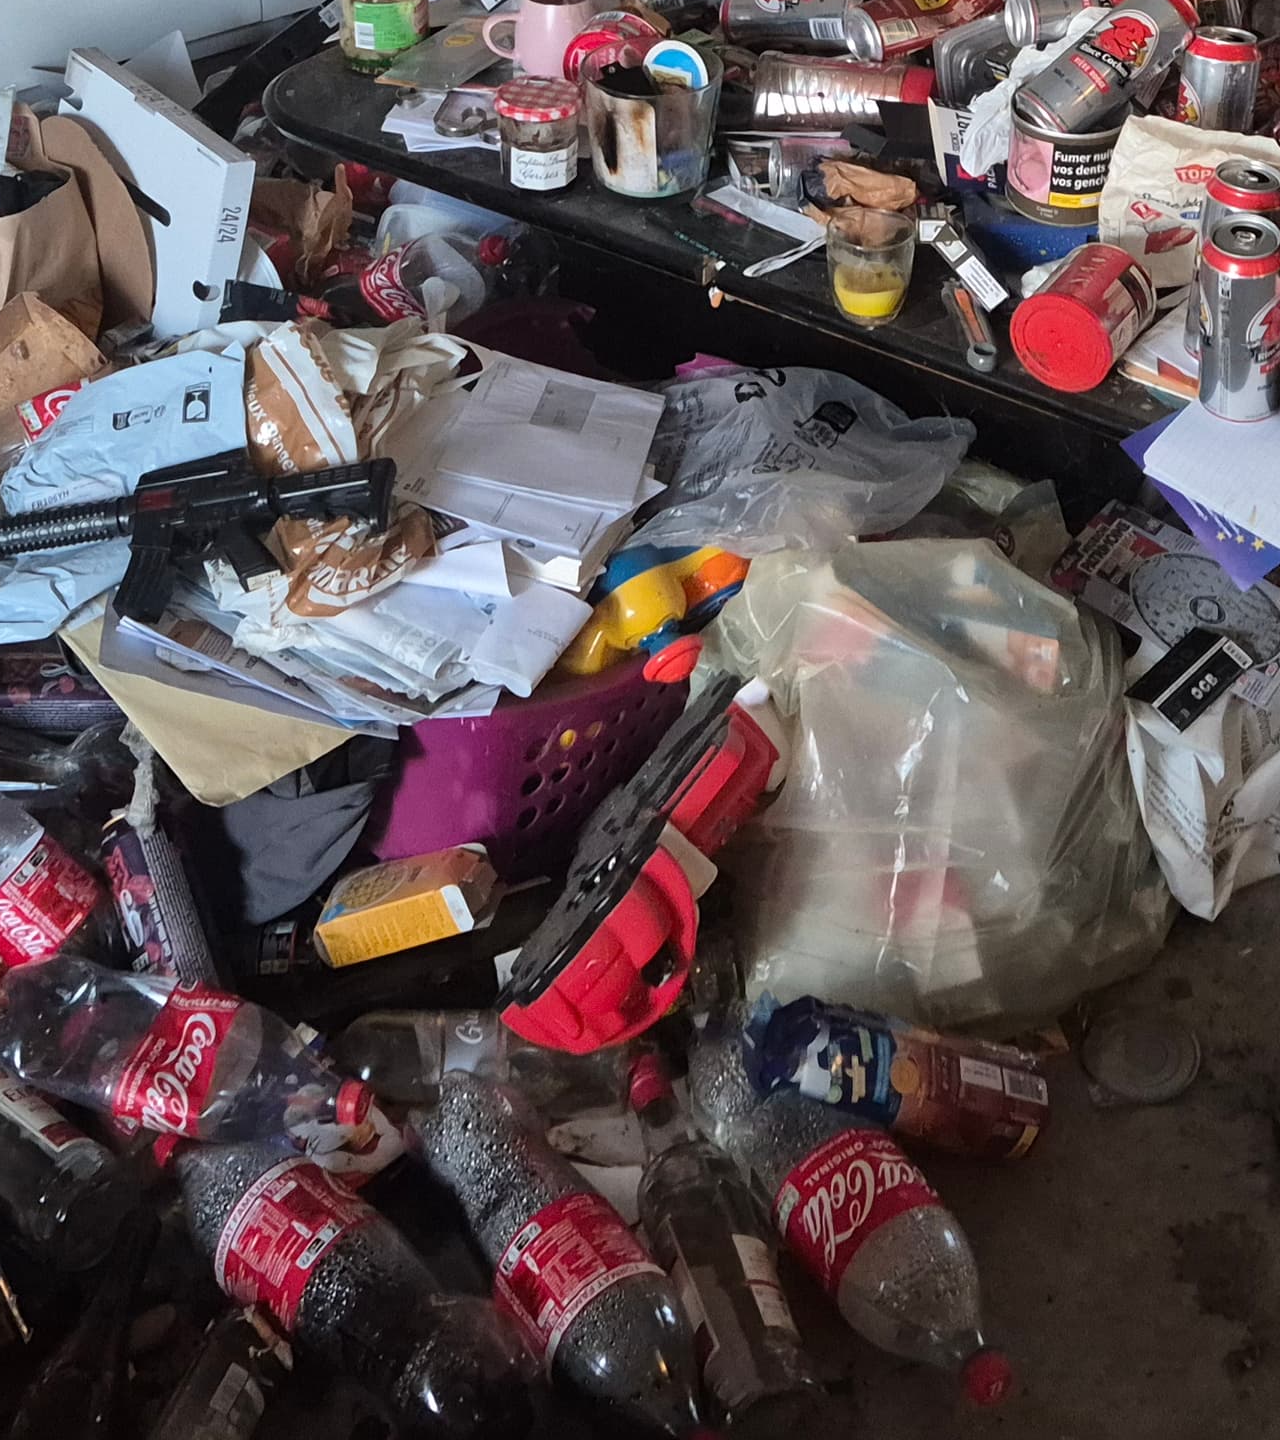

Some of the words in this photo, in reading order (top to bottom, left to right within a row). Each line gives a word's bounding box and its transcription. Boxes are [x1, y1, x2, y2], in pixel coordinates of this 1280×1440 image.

[1053, 166, 1072, 176] vos
[1075, 164, 1106, 176] dents
[1054, 151, 1091, 163] Fumer
[1052, 177, 1072, 188] vos
[216, 206, 242, 244] 24/24
[1190, 672, 1219, 700] OCB
[142, 1011, 218, 1139] Coca-Cola
[803, 1141, 865, 1188] ORIGINAL
